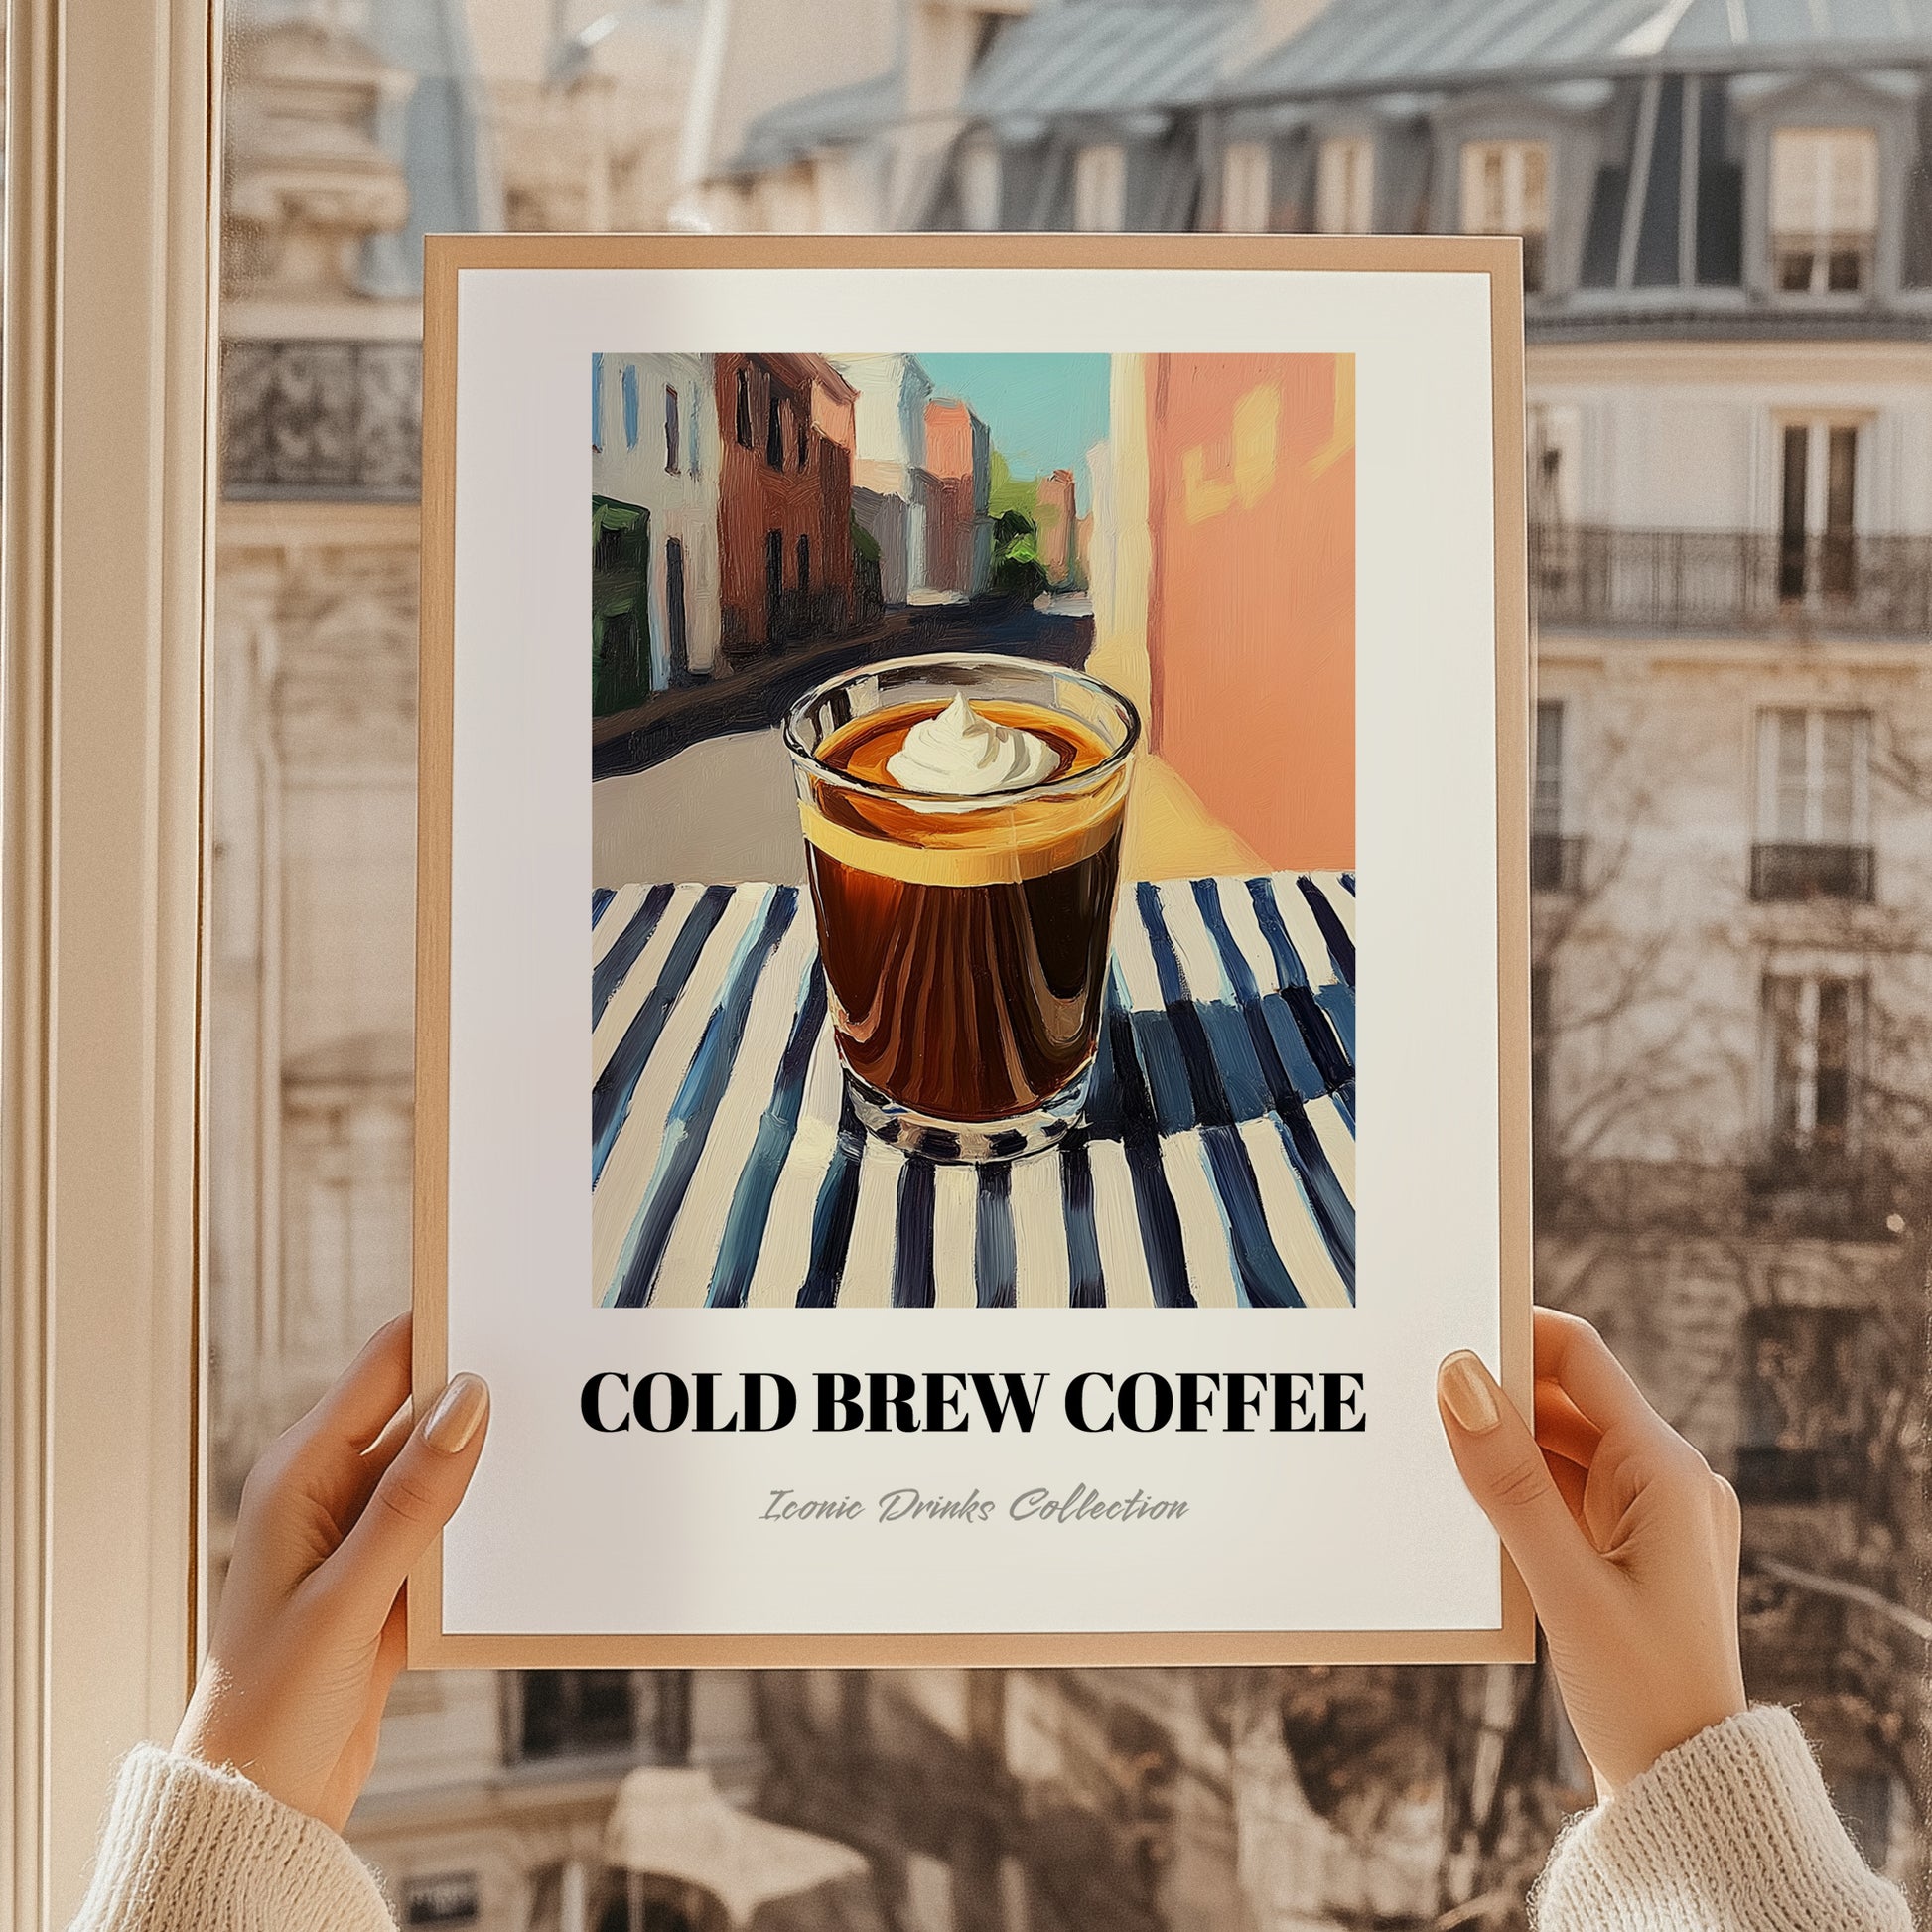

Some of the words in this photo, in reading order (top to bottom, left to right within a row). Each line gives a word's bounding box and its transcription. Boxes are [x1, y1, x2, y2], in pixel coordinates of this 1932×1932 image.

[580, 1371, 797, 1433] COLD
[812, 1372, 1051, 1433] BREW
[1064, 1371, 1367, 1433] COFFEE
[758, 1487, 866, 1522] Iconic
[878, 1487, 996, 1524] Drinks
[1009, 1481, 1190, 1524] Collection
